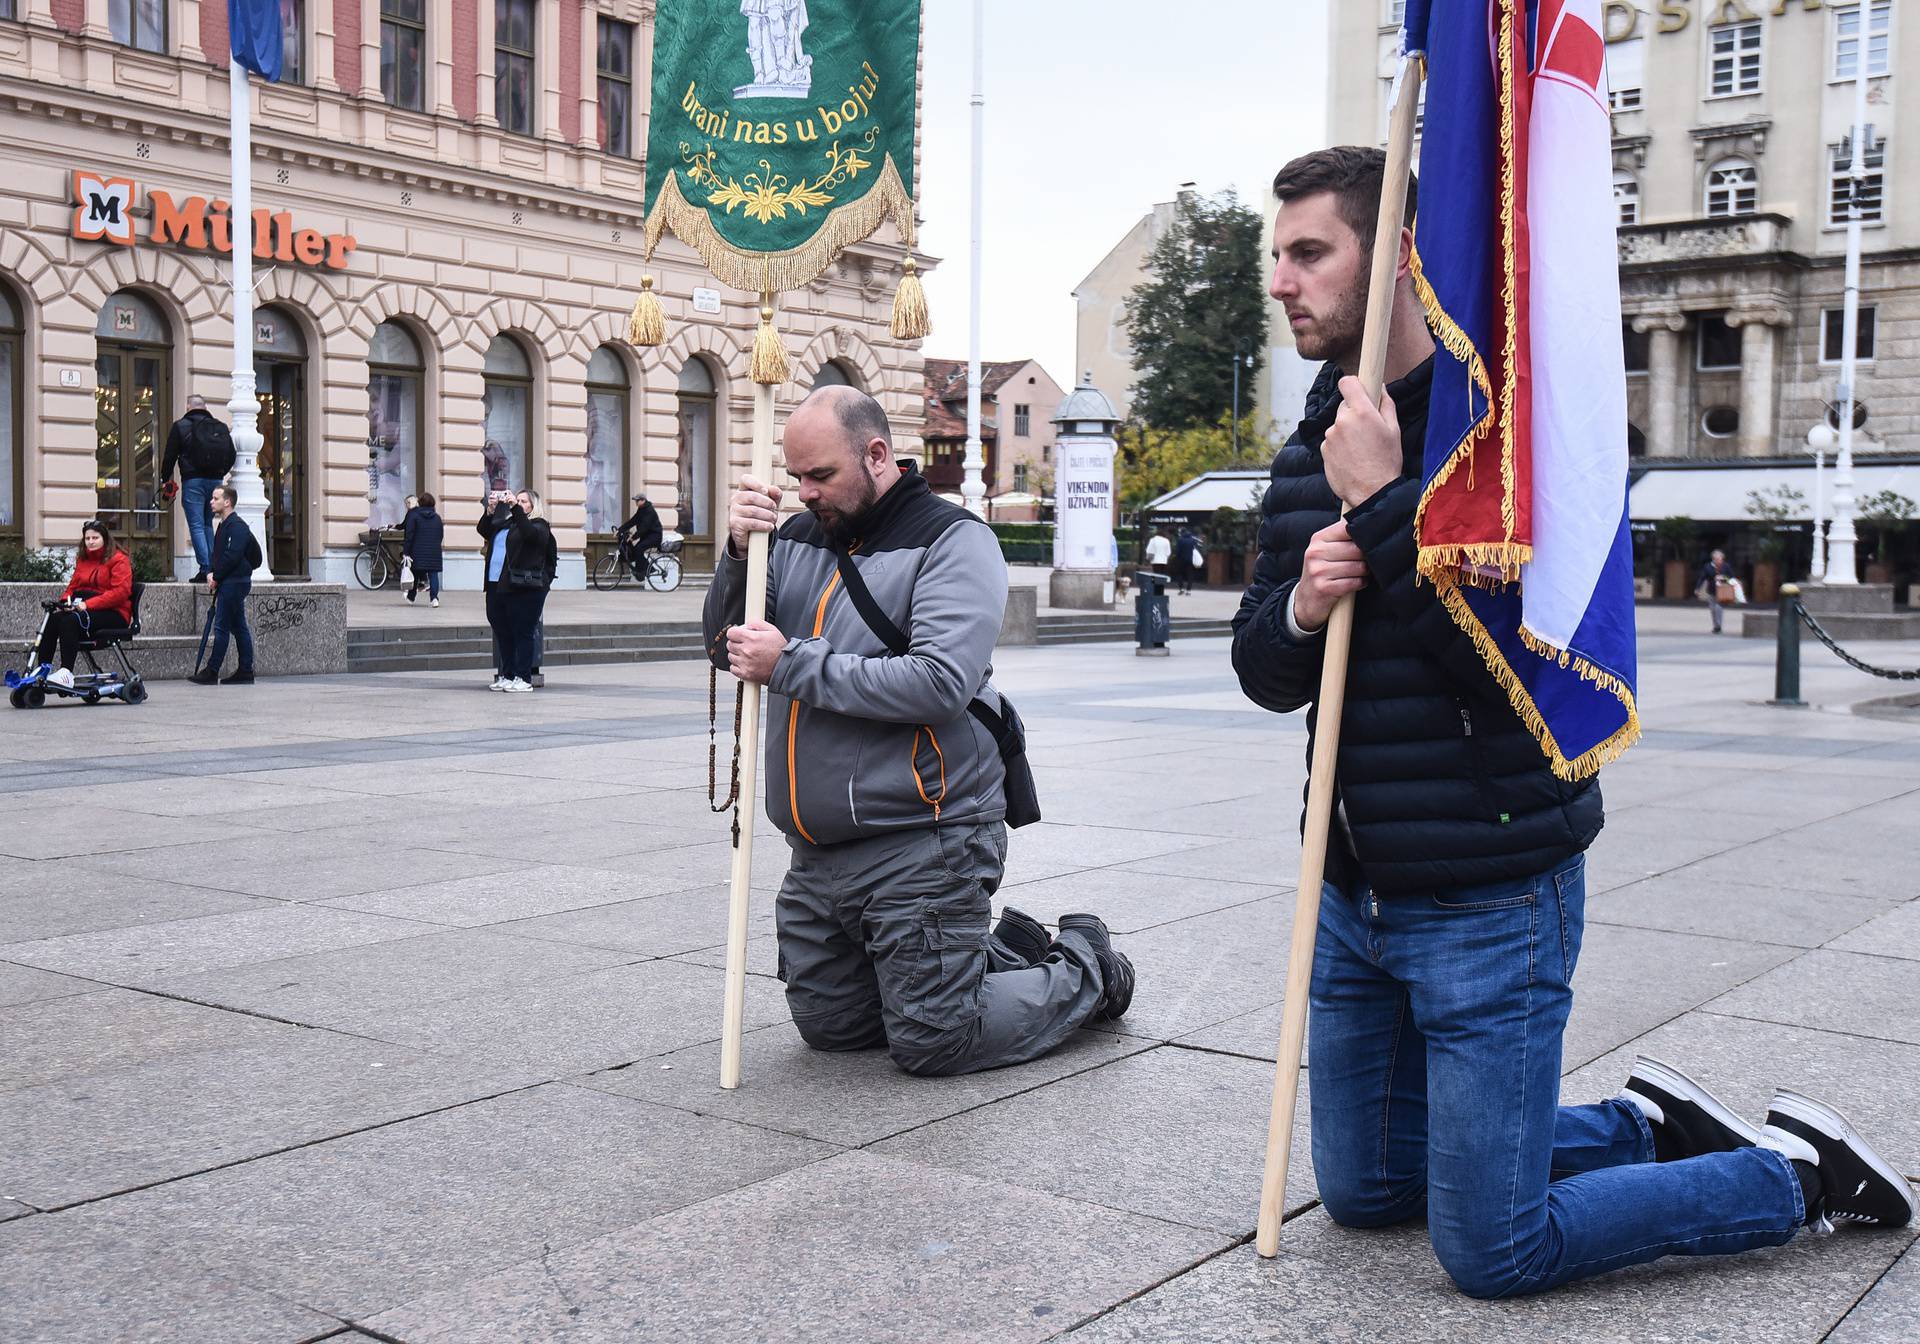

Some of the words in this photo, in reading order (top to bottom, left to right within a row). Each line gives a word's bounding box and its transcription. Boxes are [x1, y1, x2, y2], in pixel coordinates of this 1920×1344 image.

[682, 80, 729, 139] brani
[733, 119, 788, 144] nas
[795, 118, 818, 142] u
[818, 60, 879, 134] boju!
[89, 192, 120, 224] M
[1068, 494, 1109, 509] UŽIVAJTE
